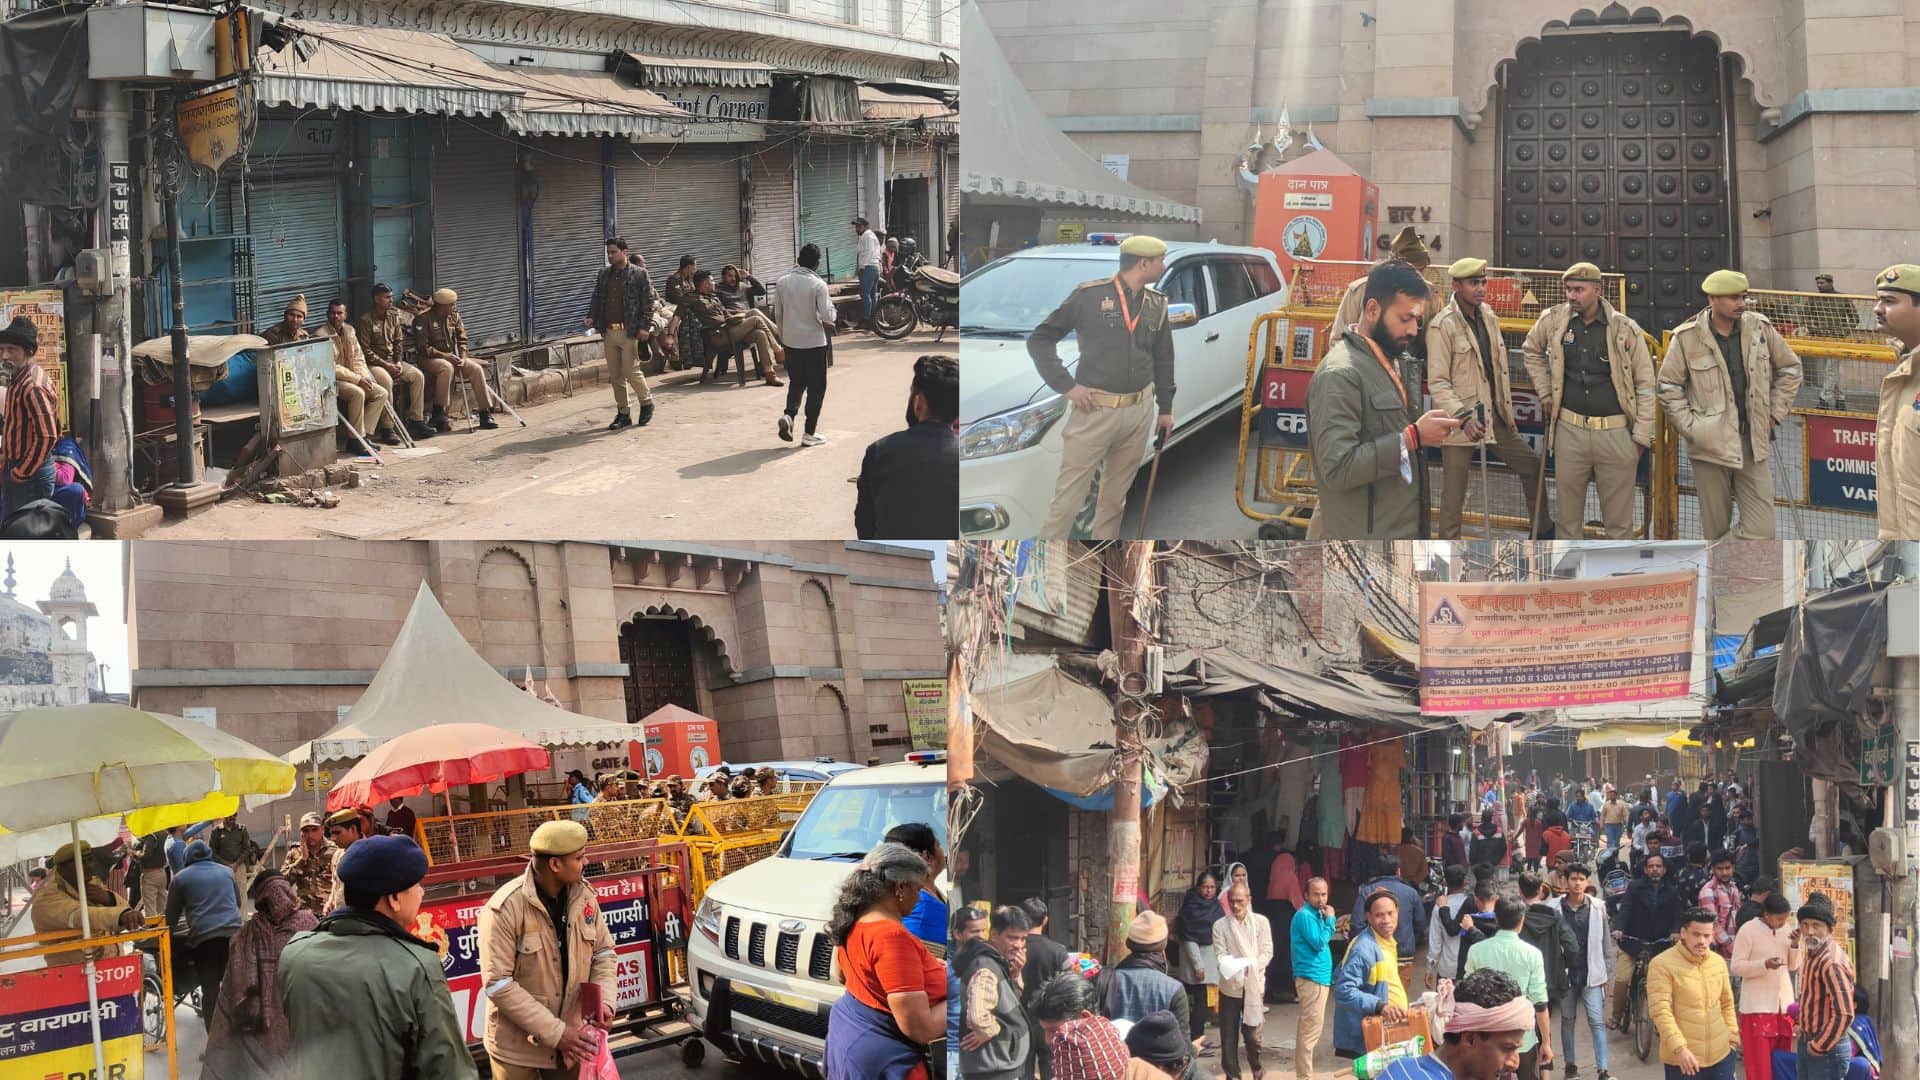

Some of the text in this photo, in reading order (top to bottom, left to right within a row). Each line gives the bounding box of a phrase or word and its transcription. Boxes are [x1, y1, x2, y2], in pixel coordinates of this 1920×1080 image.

[706, 94, 765, 122] Corner
[1288, 179, 1307, 190] दान
[1430, 234, 1442, 250] 4
[1269, 382, 1287, 400] 21
[1457, 580, 1692, 612] जनता सेवा अस्पताल
[1632, 655, 1672, 666] 15-1-2024
[1430, 677, 1471, 685] 25-1-2024
[1504, 675, 1526, 683] 11:00
[1535, 673, 1554, 681] 1:00
[591, 757, 629, 770] GATE 4
[95, 965, 135, 983] STOP
[20, 1039, 36, 1053] करें
